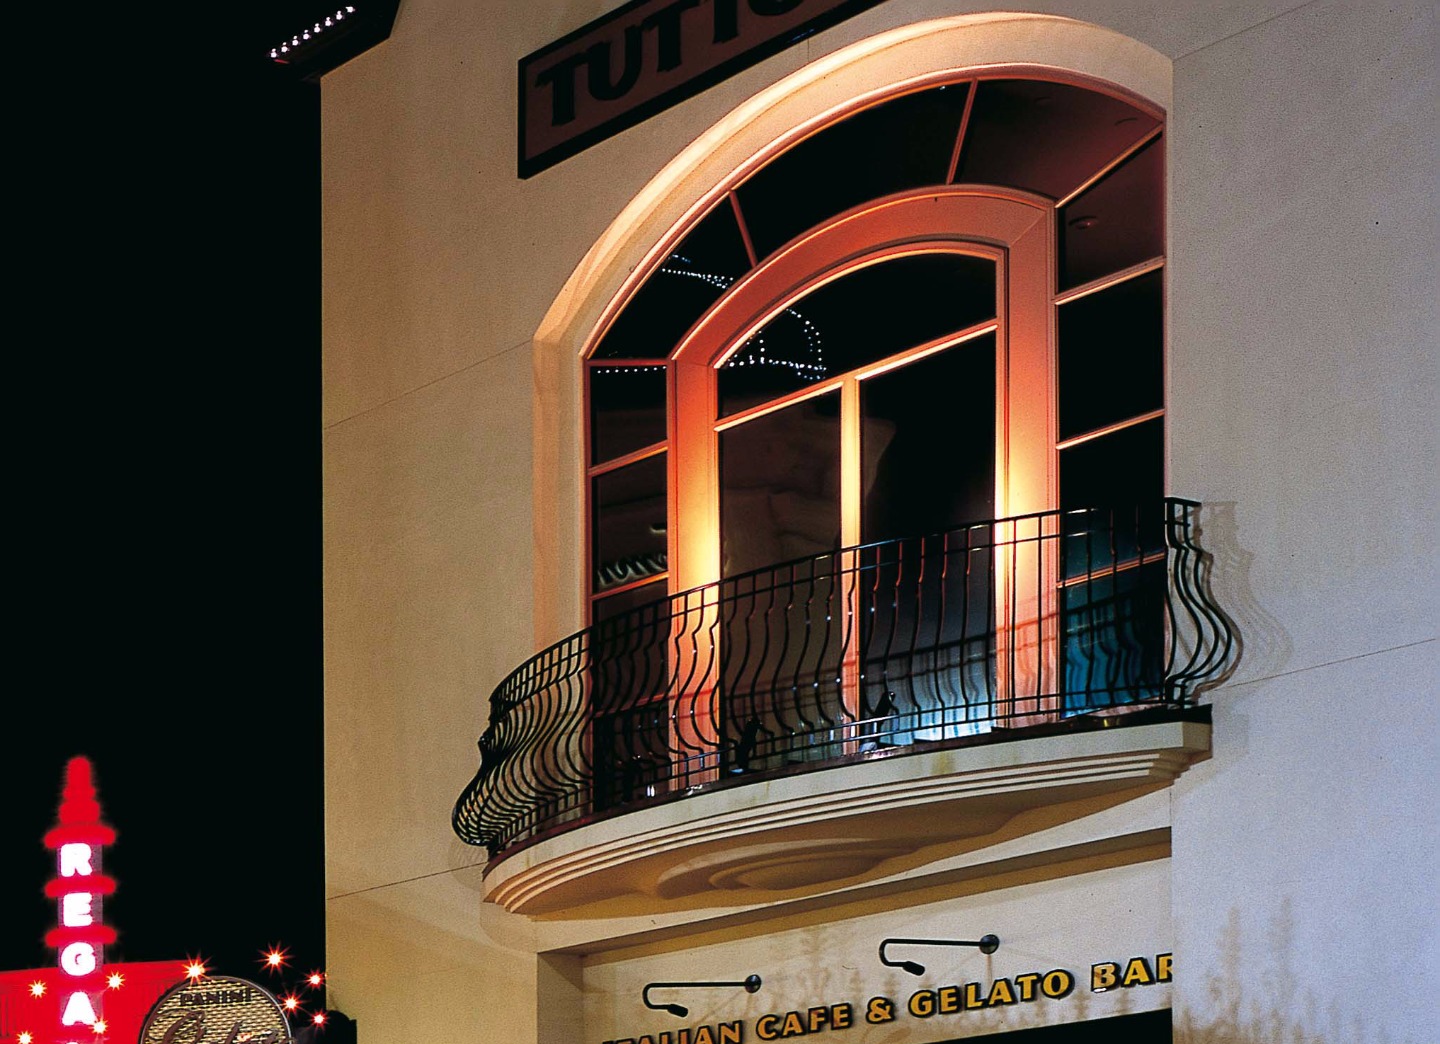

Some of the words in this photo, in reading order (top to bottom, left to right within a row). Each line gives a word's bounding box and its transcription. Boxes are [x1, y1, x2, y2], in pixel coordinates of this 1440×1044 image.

[179, 987, 253, 1007] PANINI
[755, 1001, 854, 1041] CAFE
[866, 995, 896, 1025] &
[907, 968, 1076, 1018] GELATO
